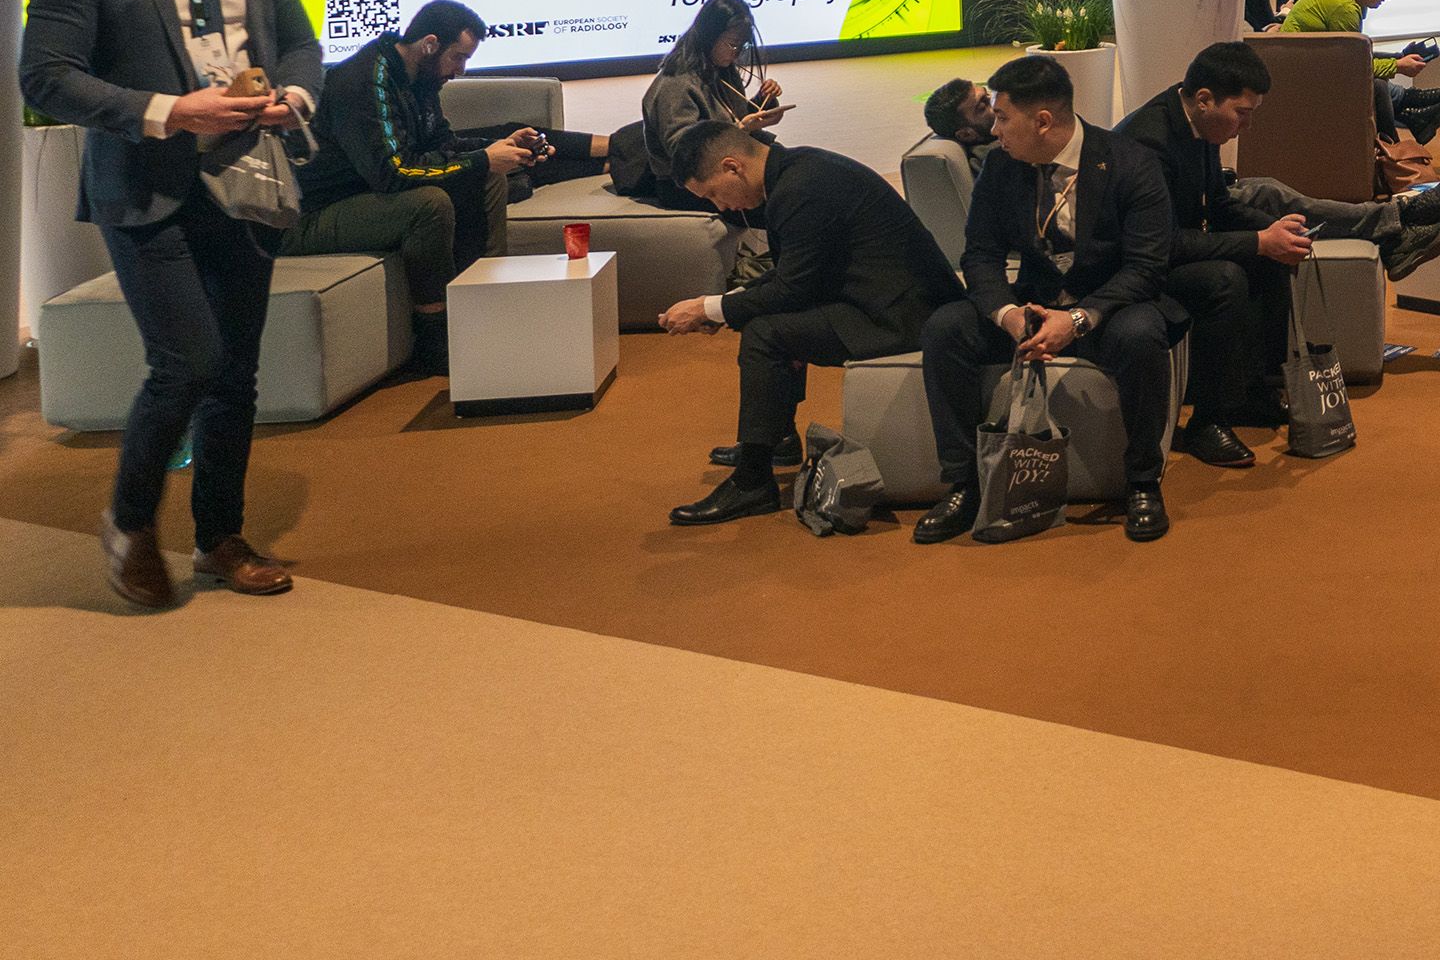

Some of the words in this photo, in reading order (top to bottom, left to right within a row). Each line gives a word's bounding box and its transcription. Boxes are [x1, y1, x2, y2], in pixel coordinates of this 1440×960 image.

[553, 17, 595, 26] EUROPEAN
[596, 15, 628, 23] SOCIETY
[553, 26, 567, 34] OF
[570, 22, 629, 33] RADIOLOGY
[328, 43, 363, 54] Downl
[1317, 376, 1345, 392] WITH
[1009, 447, 1060, 462] PACKED
[1014, 459, 1050, 469] WITH
[1007, 469, 1050, 493] JOY!
